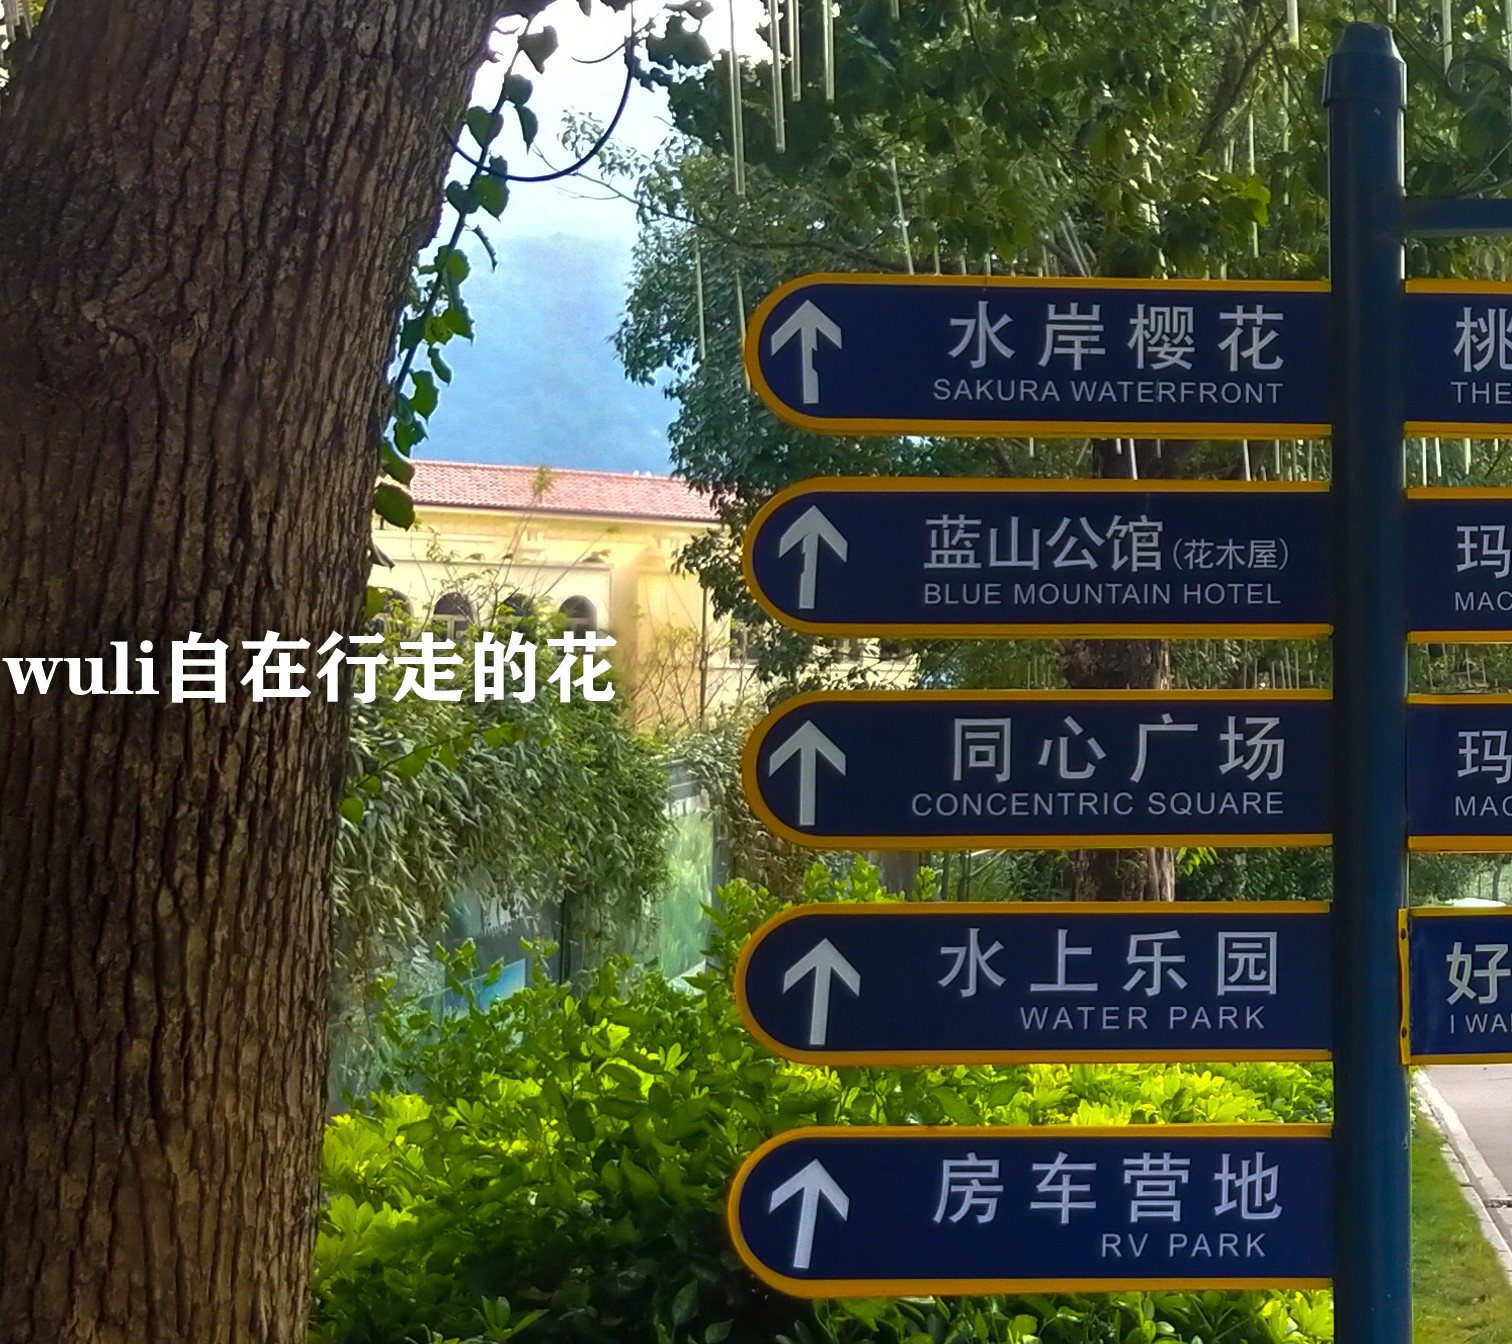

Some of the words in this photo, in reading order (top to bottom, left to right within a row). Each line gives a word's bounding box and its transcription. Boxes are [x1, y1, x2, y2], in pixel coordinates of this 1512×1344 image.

[946, 299, 1286, 374] 水岸樱花
[932, 377, 1062, 403] SAKURA
[1069, 379, 1285, 406] WATERFRONT
[1450, 380, 1512, 406] THE
[923, 581, 1003, 606] BLUE
[1012, 581, 1172, 607] MOUNTAIN
[1182, 581, 1282, 606] HOTEL
[950, 712, 1287, 785] 同心广场
[910, 791, 1135, 818] CONCENTRIC
[1146, 790, 1286, 818] SQUARE
[937, 926, 1279, 999] 水上乐园
[1019, 1004, 1150, 1032] WATER
[1168, 1004, 1267, 1031] PARK
[1447, 1012, 1457, 1035] I
[931, 1150, 1285, 1226] 房车营地
[1100, 1232, 1150, 1259] RV
[1167, 1232, 1267, 1259] PARK
